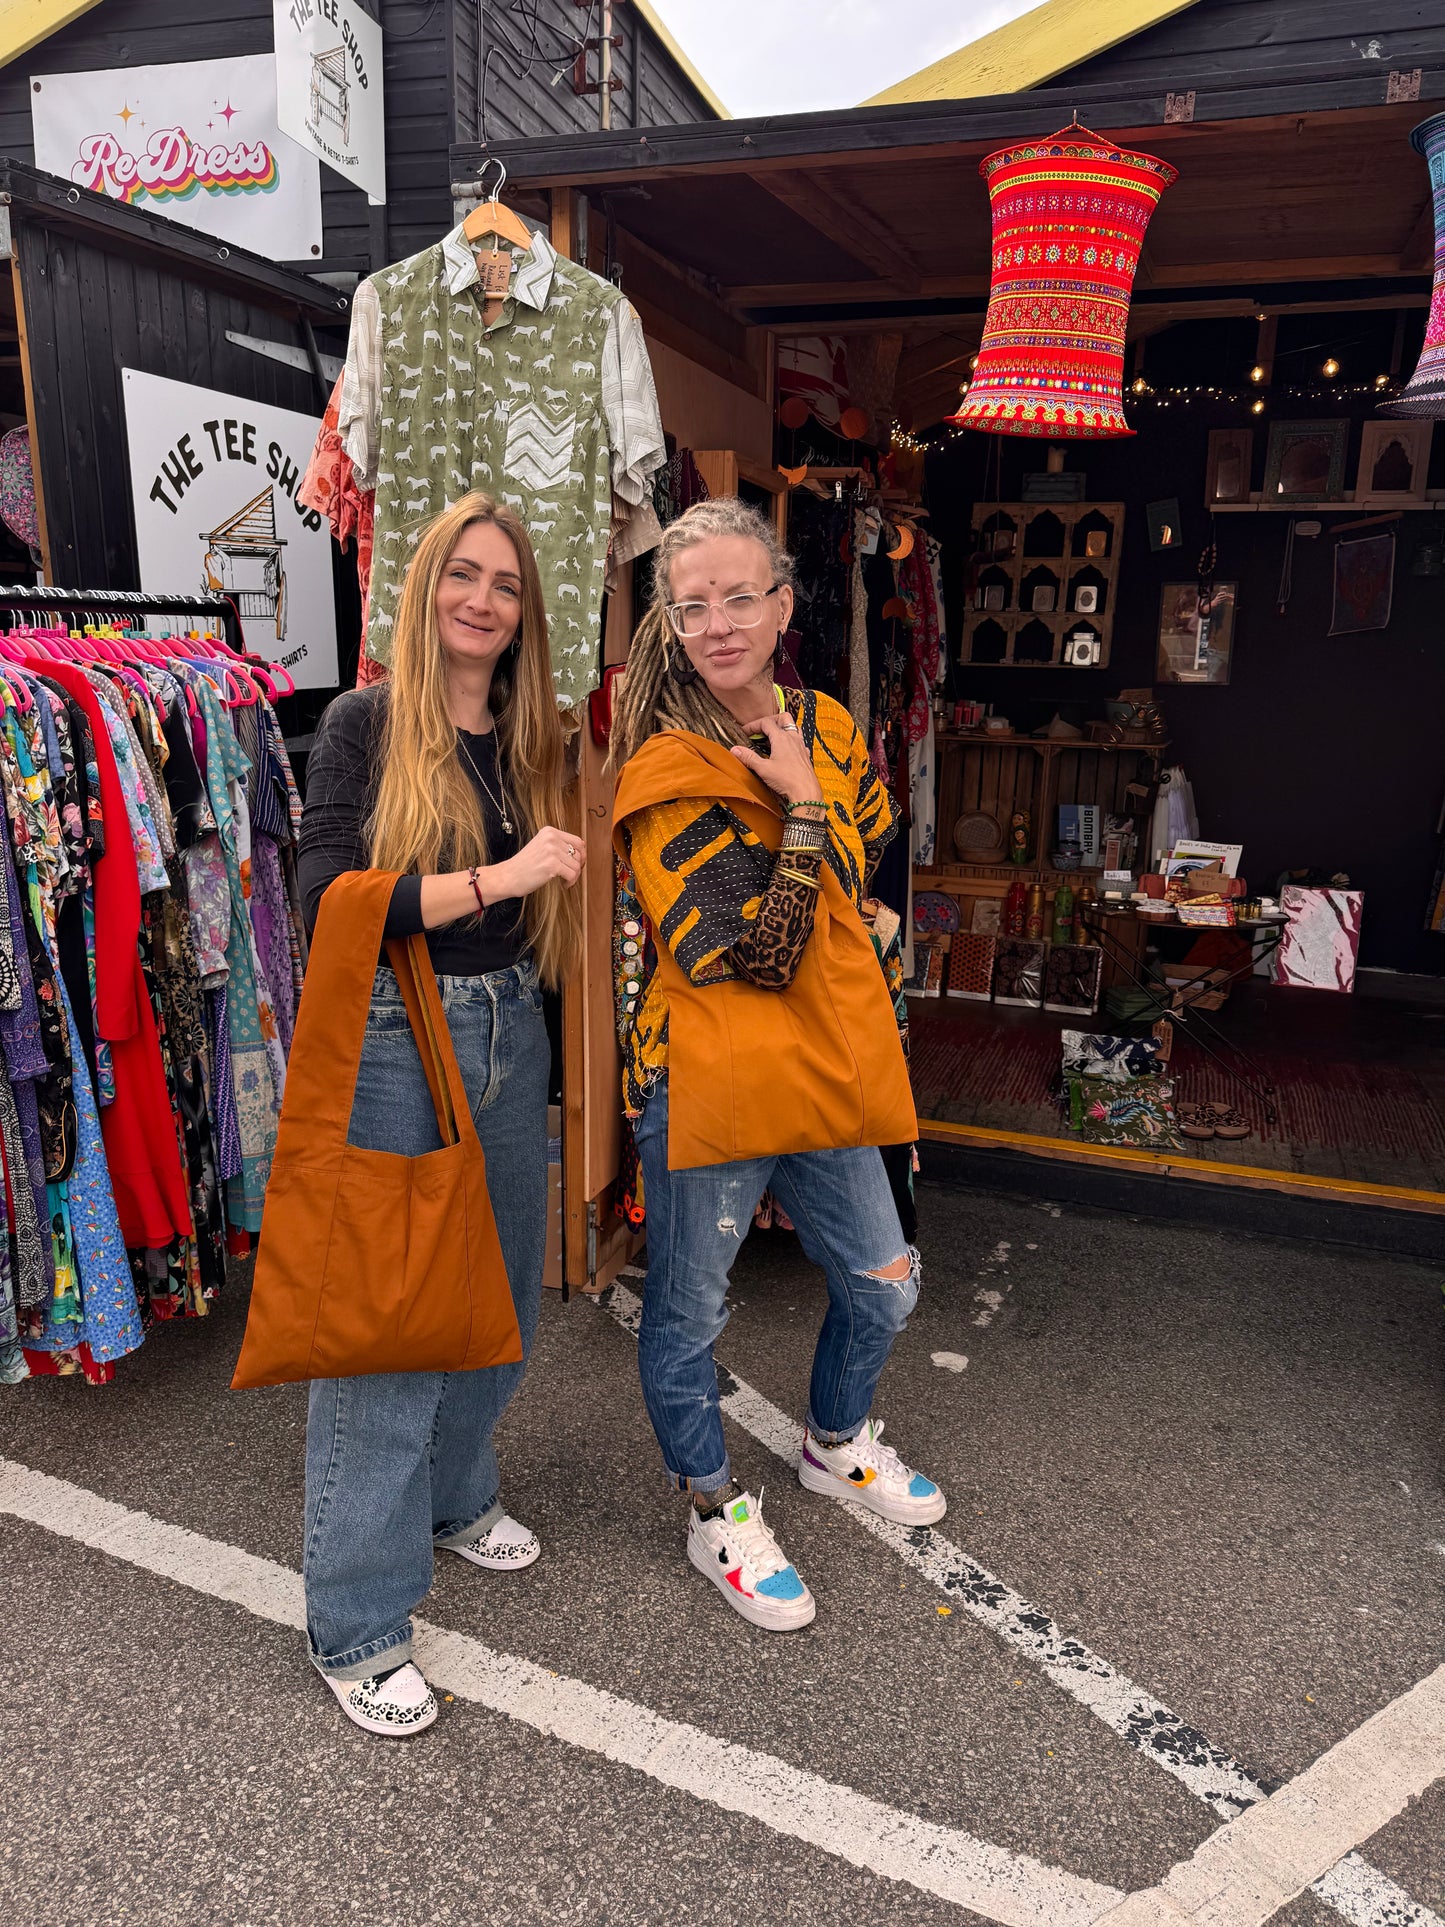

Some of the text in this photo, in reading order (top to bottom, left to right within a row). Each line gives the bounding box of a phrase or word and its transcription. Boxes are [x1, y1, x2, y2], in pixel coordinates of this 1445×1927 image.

[342, 19, 368, 90] SHOP
[71, 127, 277, 203] ReDress
[149, 432, 203, 515] THE
[203, 419, 257, 466] TEE
[1083, 809, 1094, 855] BOMBAY
